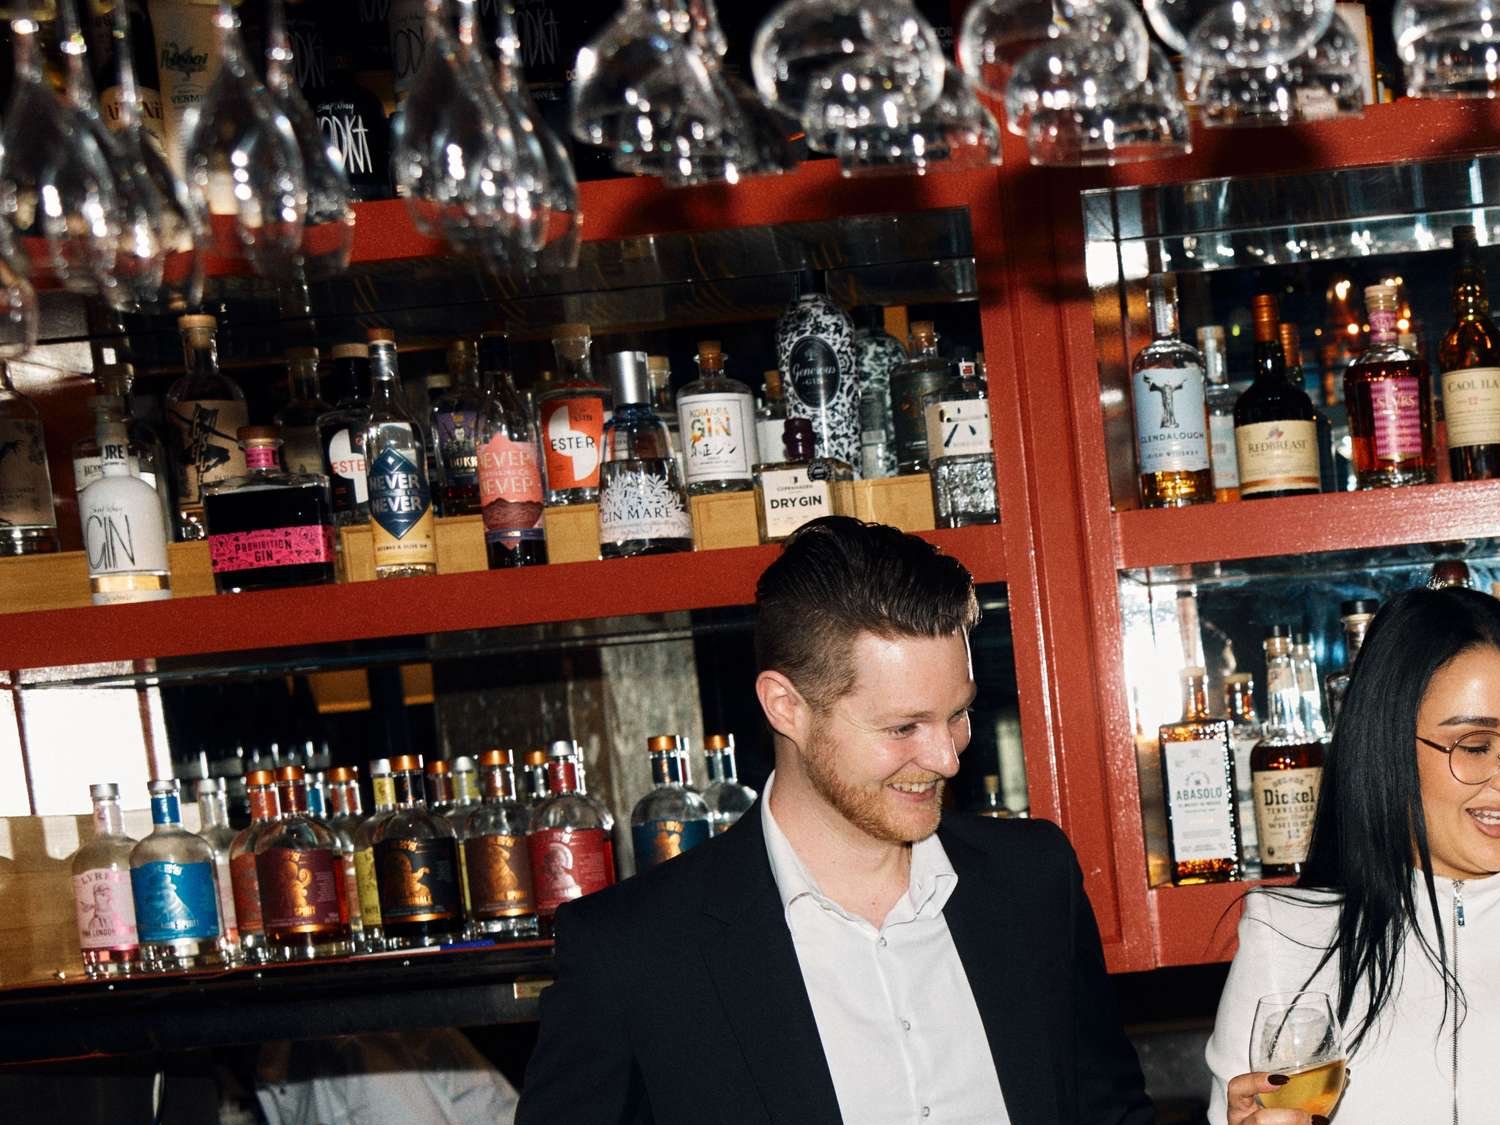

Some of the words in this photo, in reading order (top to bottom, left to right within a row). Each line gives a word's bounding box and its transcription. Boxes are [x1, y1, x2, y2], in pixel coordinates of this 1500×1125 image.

[316, 115, 373, 174] ODKA
[1448, 379, 1475, 393] CAOL
[1480, 379, 1500, 389] ILA
[551, 435, 595, 452] ESTER
[1140, 431, 1204, 444] GLENDALOUGH
[331, 459, 367, 475] ESTE
[369, 471, 421, 491] NEVER
[371, 494, 423, 514] NEVER
[771, 497, 799, 509] DRY
[799, 495, 823, 507] GIN
[601, 509, 623, 524] GIN
[627, 505, 673, 521] MARE
[86, 514, 136, 570] GIN
[254, 550, 274, 563] GIN
[1176, 786, 1223, 801] ABASOLO
[1263, 786, 1316, 806] Dickel
